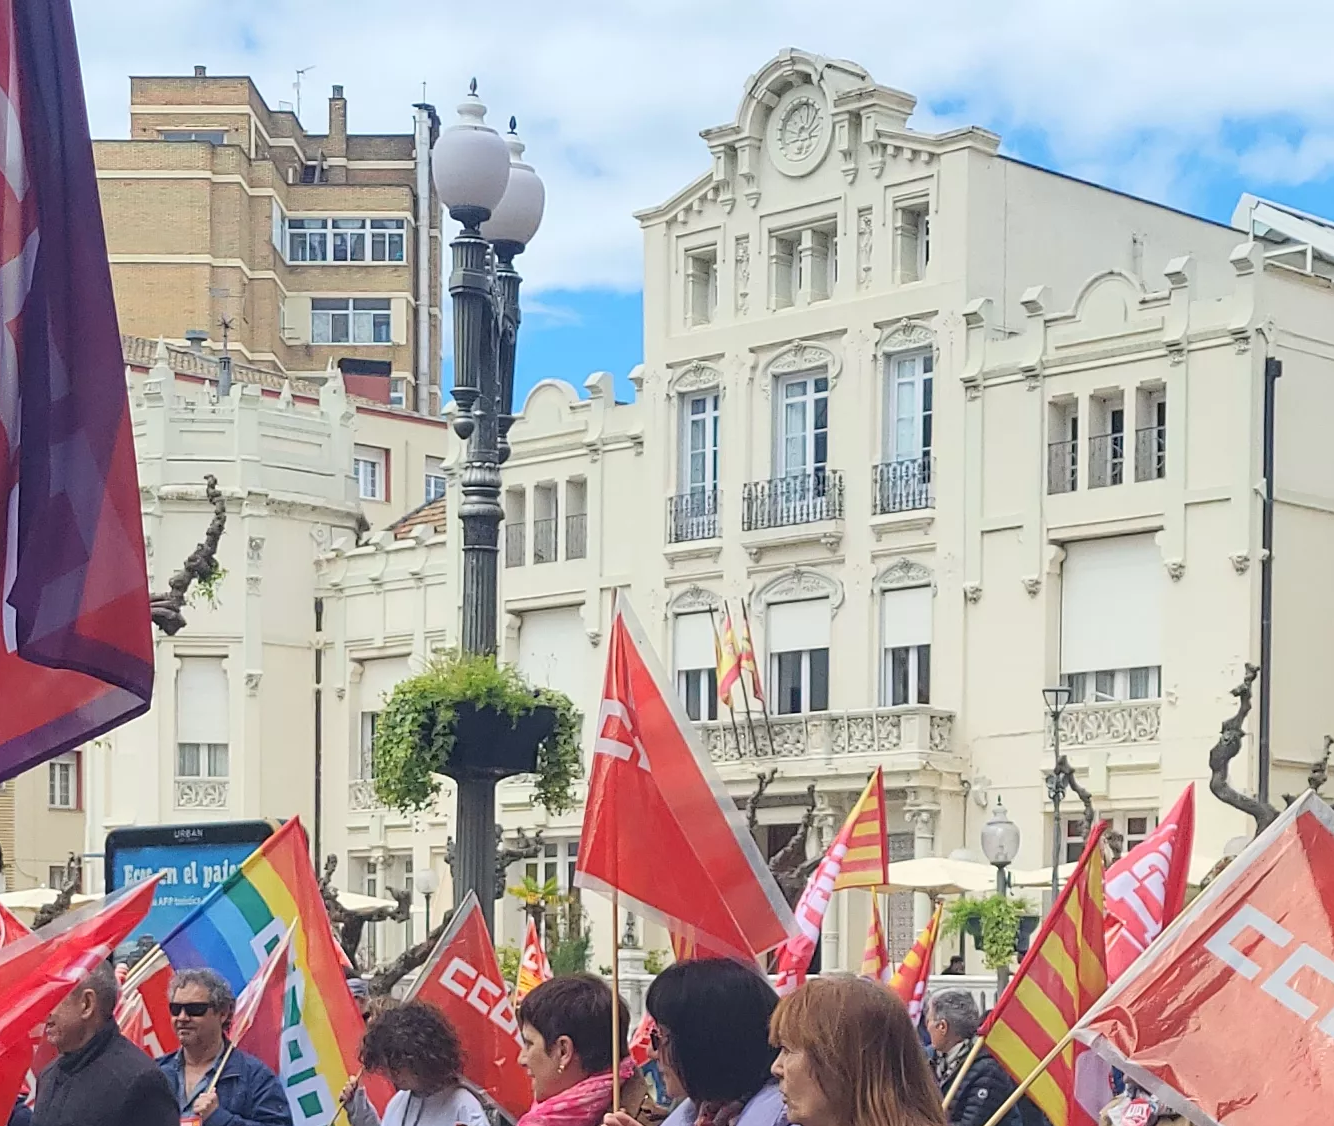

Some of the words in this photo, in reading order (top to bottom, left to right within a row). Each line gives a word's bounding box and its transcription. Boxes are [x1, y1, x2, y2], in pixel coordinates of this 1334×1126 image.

[173, 828, 204, 839] URBAN
[183, 861, 198, 885] el
[438, 956, 526, 1049] CCO
